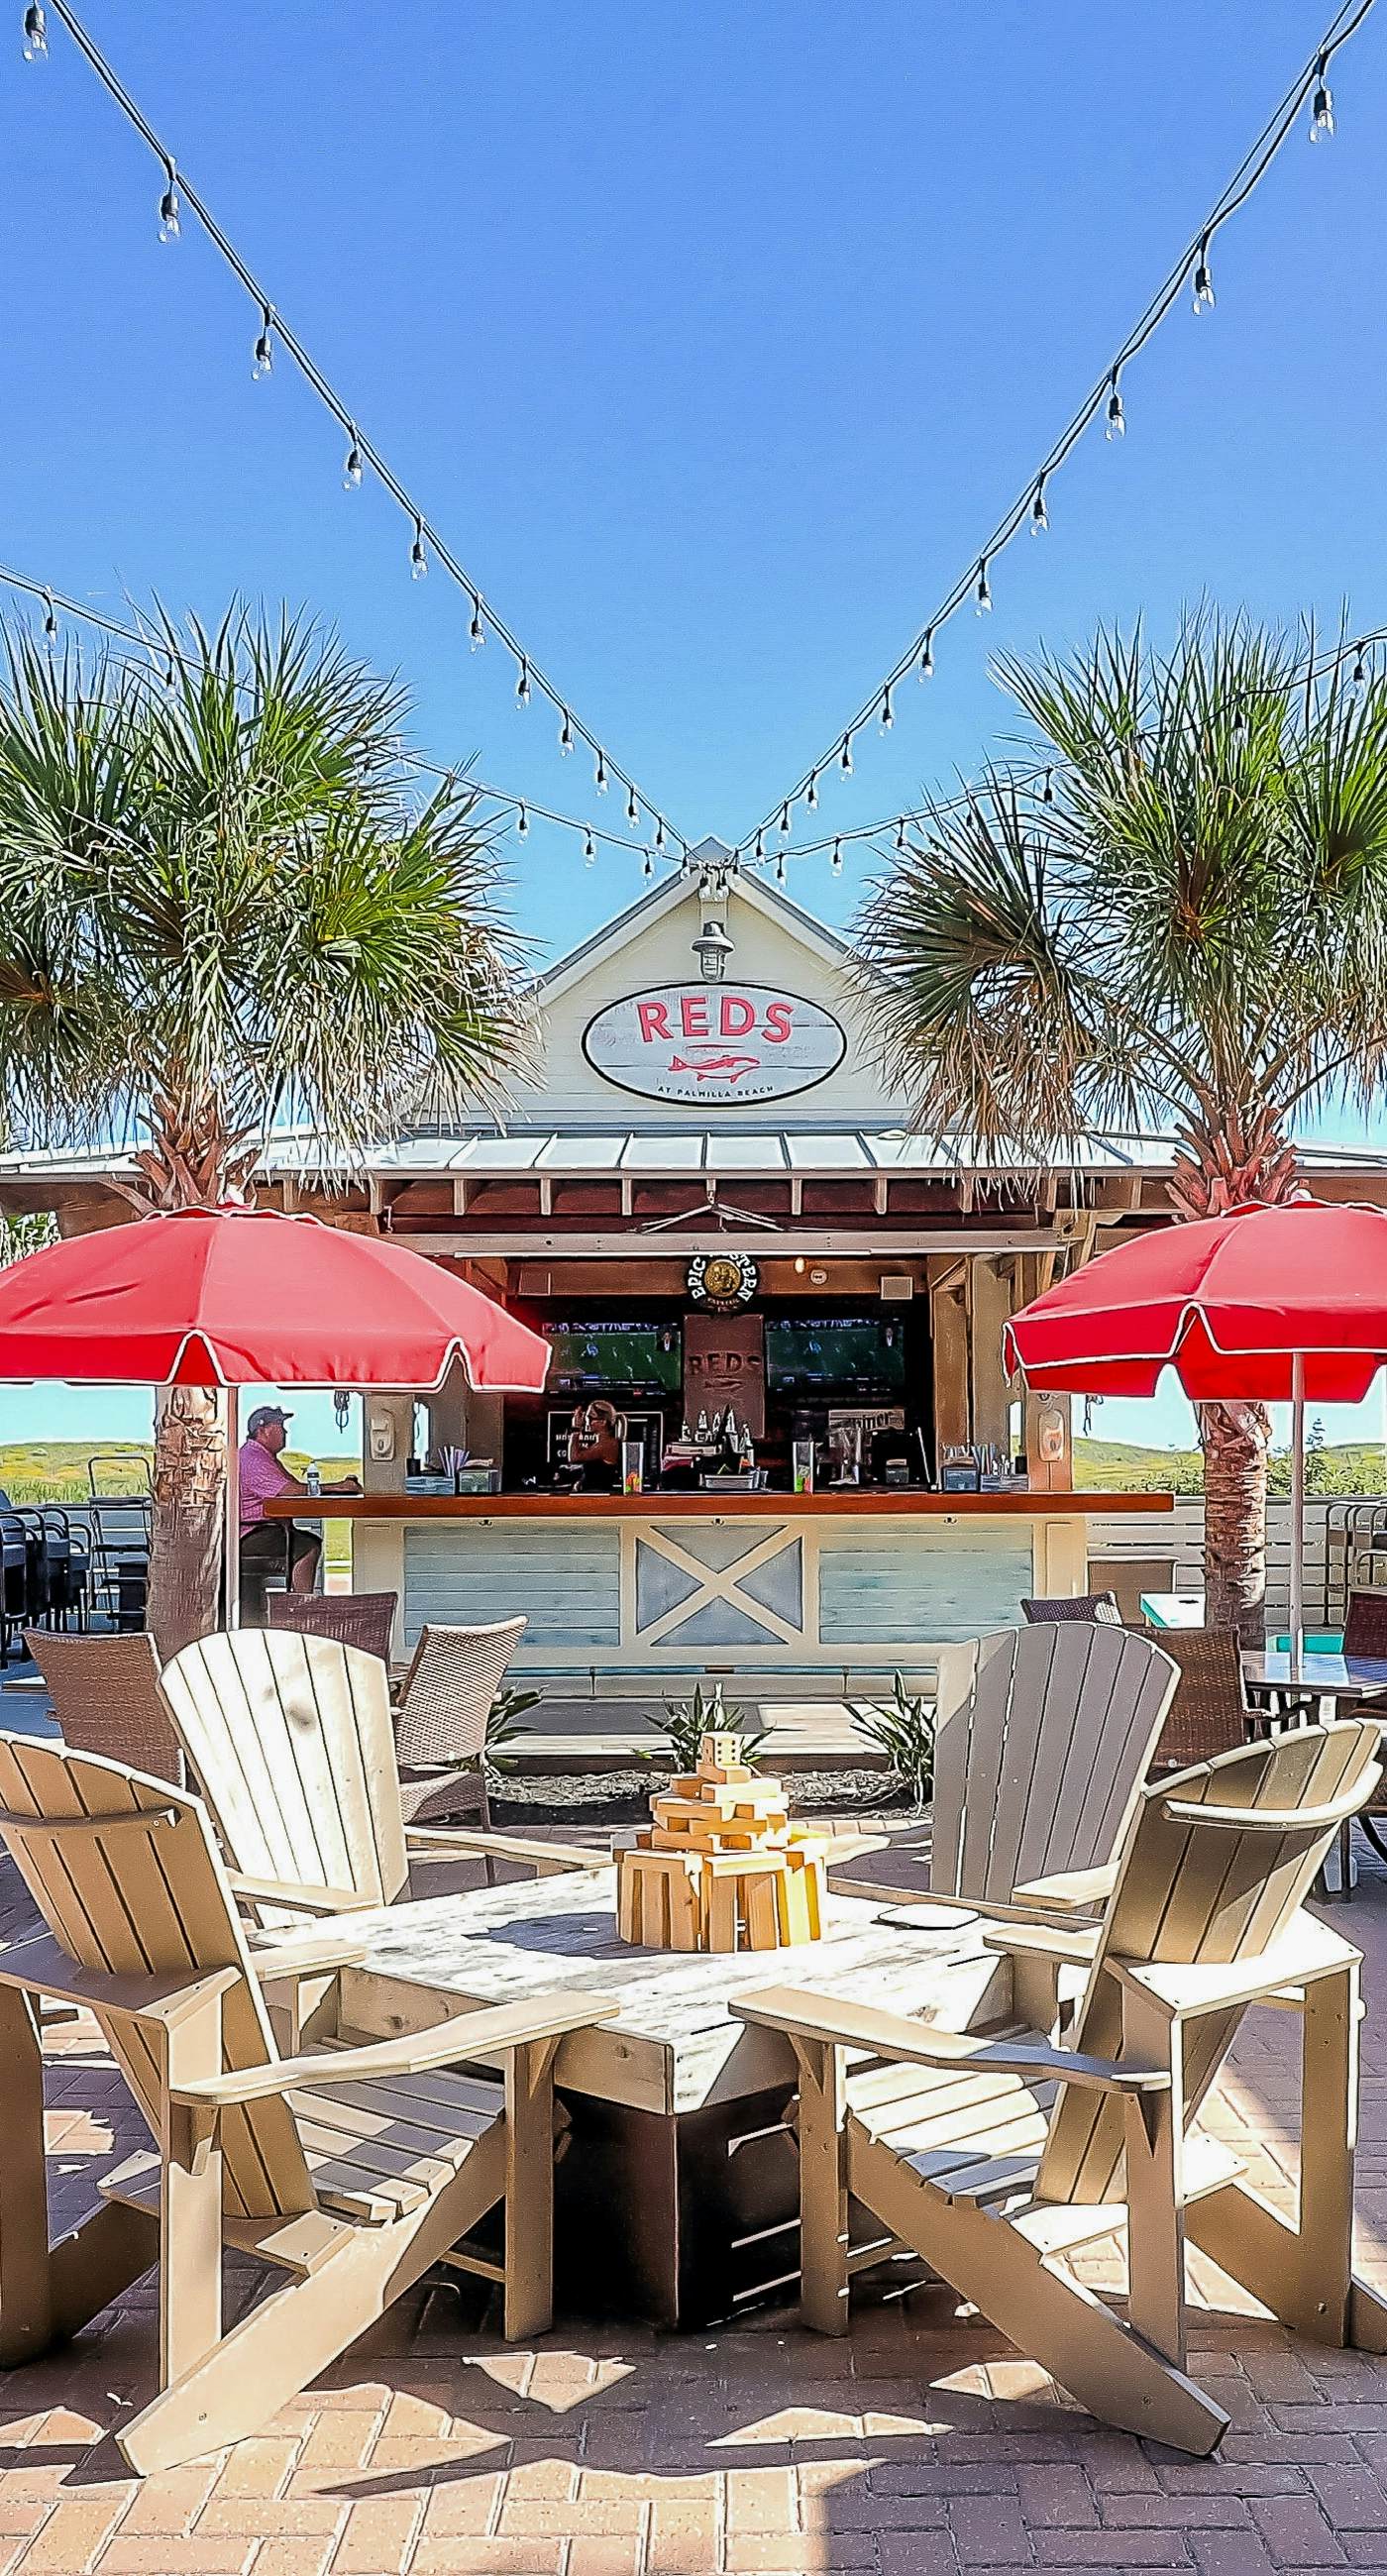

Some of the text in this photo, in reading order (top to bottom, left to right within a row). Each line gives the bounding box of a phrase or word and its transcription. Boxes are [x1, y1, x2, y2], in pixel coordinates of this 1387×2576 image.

[637, 995, 794, 1042] REDS
[678, 1089, 731, 1098] PALMILLA
[737, 1086, 774, 1097] BEACH
[688, 1256, 706, 1300] EPIC
[689, 1352, 761, 1375] REDS
